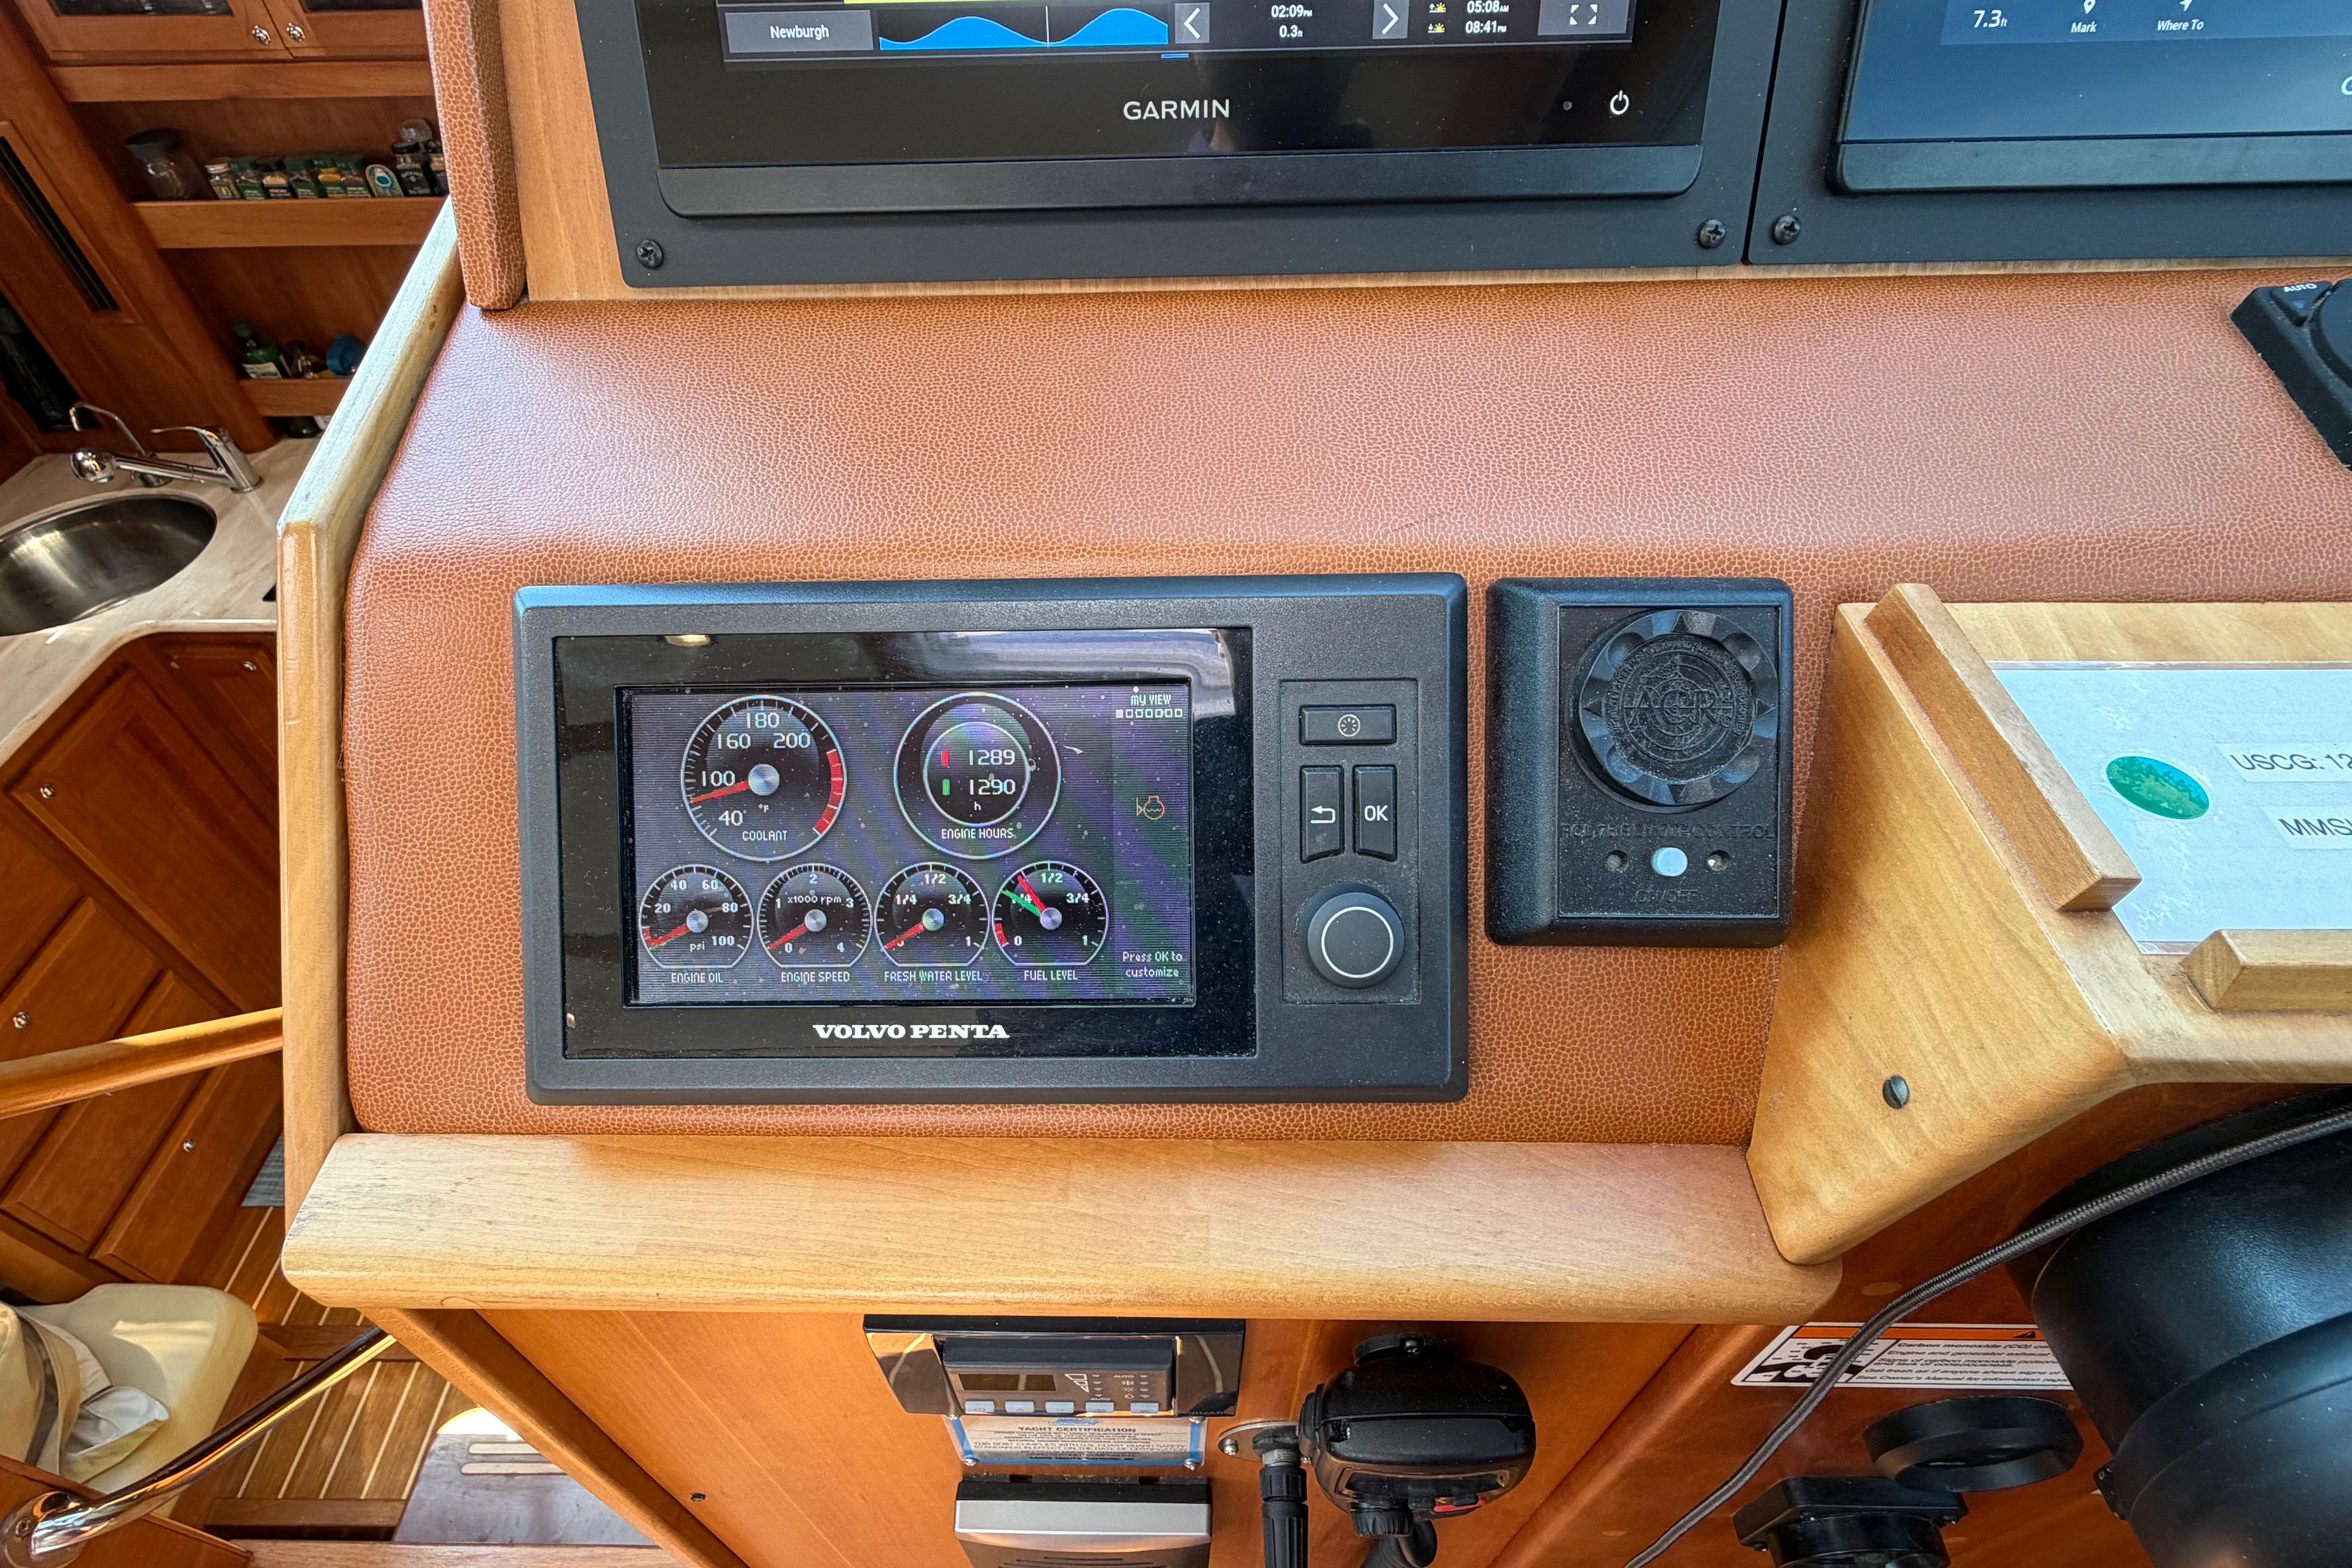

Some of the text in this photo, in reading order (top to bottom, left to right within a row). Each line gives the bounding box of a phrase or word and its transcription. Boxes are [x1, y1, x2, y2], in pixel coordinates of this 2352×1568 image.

[1465, 20, 1507, 33] 08:41PM
[2071, 21, 2098, 33] Mark
[2157, 19, 2204, 31] Where To
[770, 24, 829, 40] Newburgh
[1123, 99, 1230, 120] GARMIN
[2283, 283, 2318, 293] AUTO
[1149, 693, 1171, 705] VIEW
[746, 712, 780, 729] 180
[718, 733, 751, 749] 160
[773, 732, 811, 749] 200
[969, 749, 1015, 765] 1289
[2229, 754, 2325, 770] USCG:
[702, 770, 735, 787] 100
[970, 779, 1016, 795] 1290
[974, 801, 981, 810] h
[719, 810, 743, 826] 40
[1364, 805, 1388, 821] OK
[742, 830, 788, 842] COOLANT
[941, 828, 1014, 839] ENGINE HOURS
[809, 874, 817, 884] 2
[924, 874, 946, 884] 1/2
[1041, 873, 1063, 883] 1/2
[671, 880, 687, 890] 40
[702, 880, 718, 890] 60
[776, 898, 781, 909] 1
[821, 896, 841, 905] rpm
[846, 898, 854, 908] 3
[896, 894, 917, 905] 1/4
[948, 894, 971, 904] 3/4
[1066, 893, 1090, 903] 3/4
[655, 903, 671, 913] 20
[721, 903, 738, 913] 80
[712, 936, 735, 946] 100
[966, 936, 971, 946] 1
[1014, 936, 1022, 946] 0
[1082, 935, 1087, 945] 1
[690, 941, 705, 952] psi
[785, 943, 793, 953] 0
[837, 942, 845, 952] 4
[1122, 951, 1183, 961] Press OK to
[884, 970, 982, 982] FRESH WATER LEVEL
[1024, 970, 1078, 980] FUEL LEVEL
[1125, 966, 1179, 977] customize
[671, 973, 723, 983] ENGINE OIL
[781, 972, 850, 983] ENGINE SPEED
[812, 1024, 1010, 1039] VOLVO PENTA
